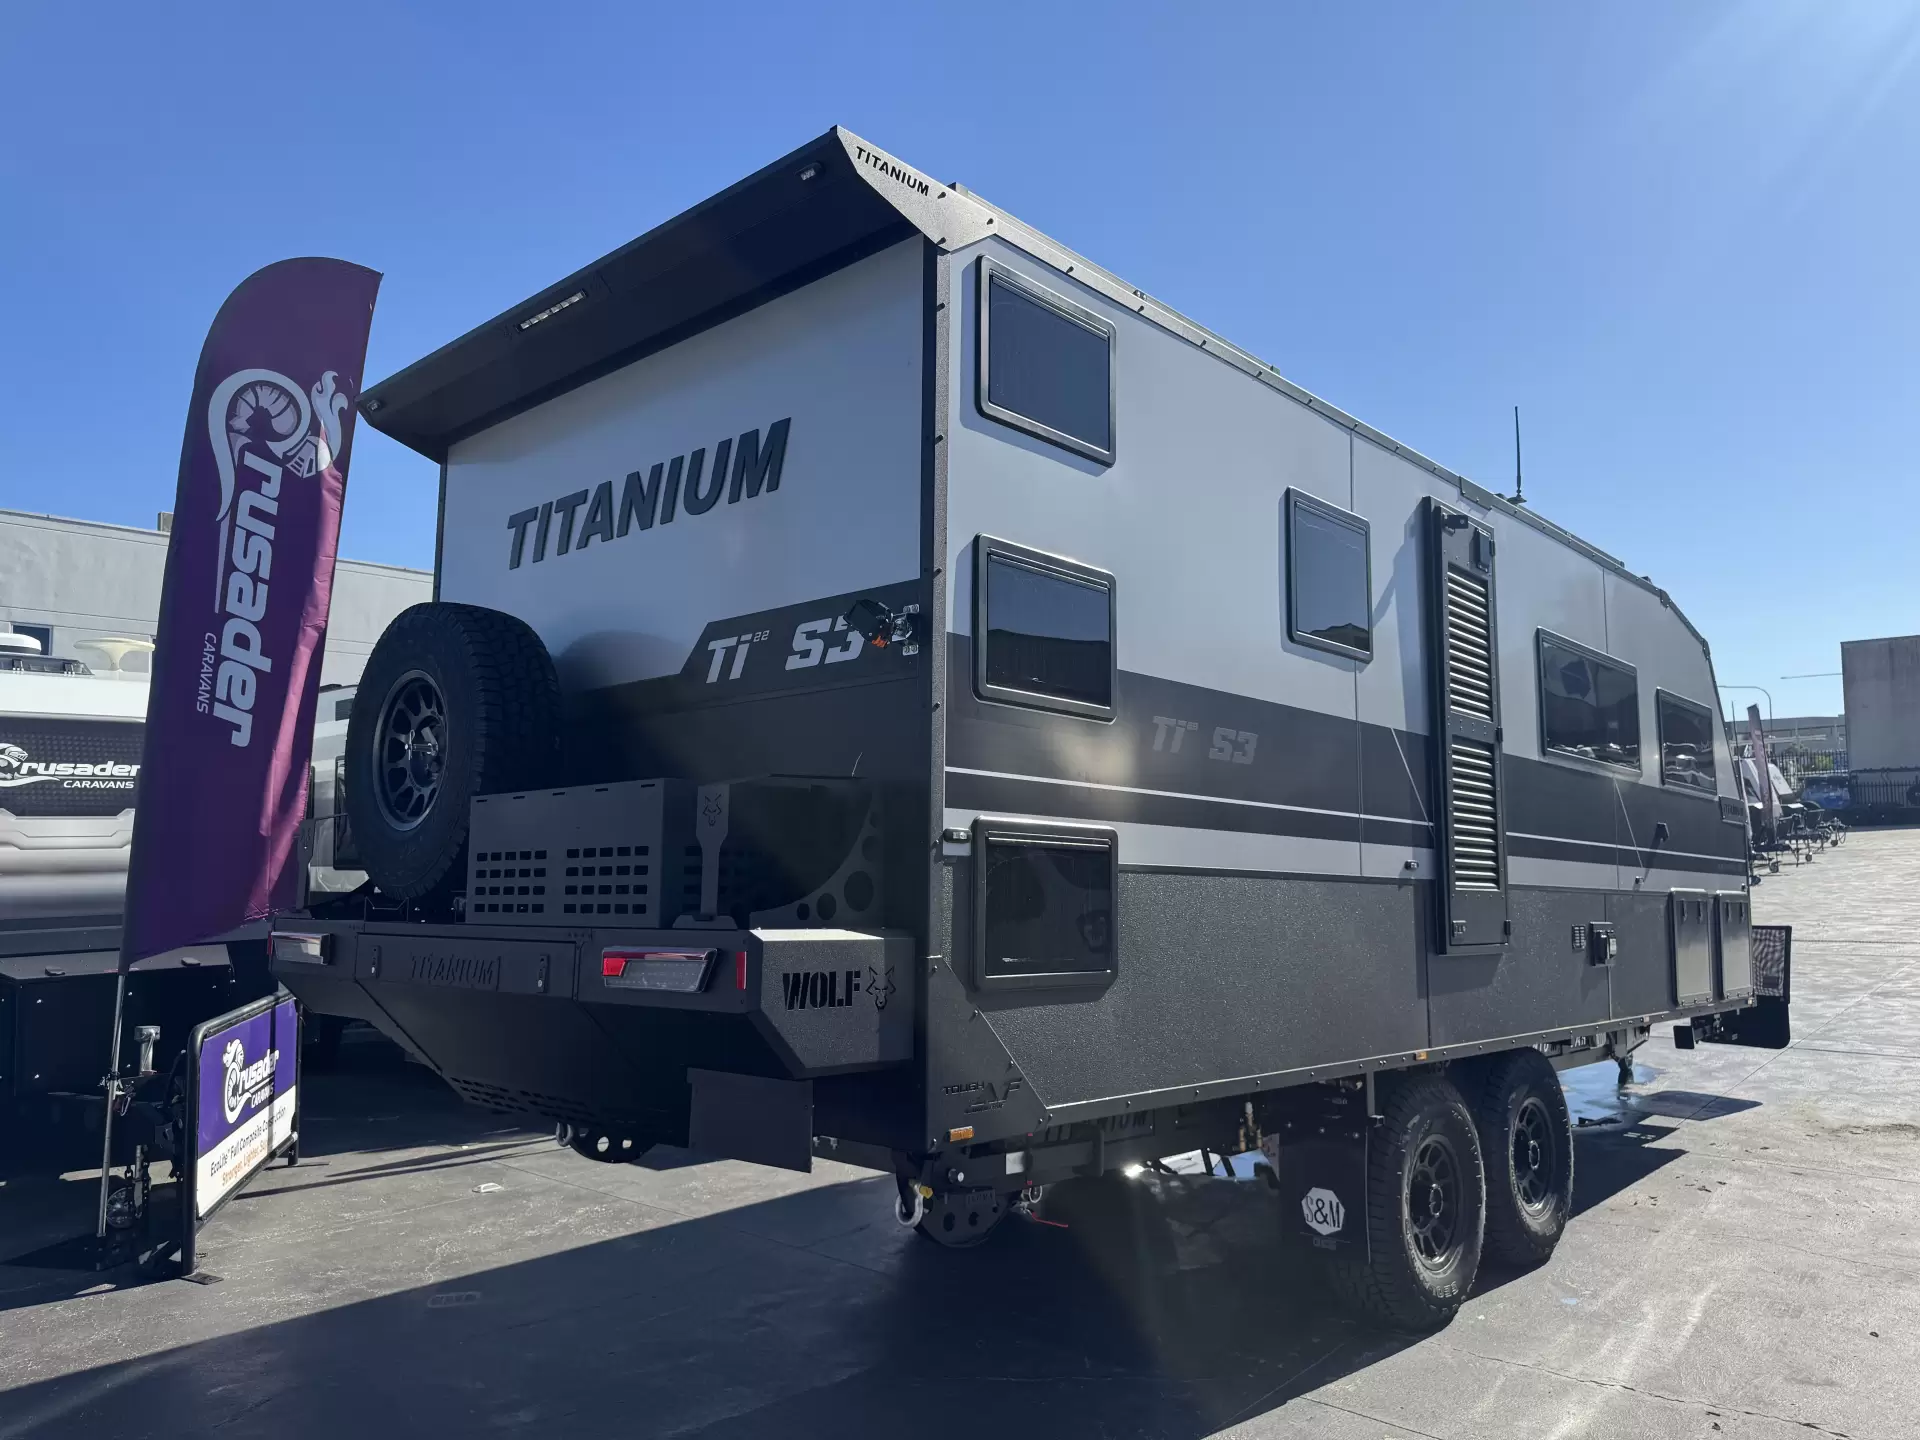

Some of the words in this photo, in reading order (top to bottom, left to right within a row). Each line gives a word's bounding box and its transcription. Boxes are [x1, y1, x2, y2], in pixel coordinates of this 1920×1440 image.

[855, 145, 930, 197] TITANIUM
[507, 415, 792, 570] TITANIUM
[208, 368, 312, 748] Crusader
[784, 615, 865, 672] S3
[196, 632, 216, 714] CARAVANS
[1208, 726, 1260, 765] S3
[63, 780, 135, 789] CARAVANS
[411, 955, 495, 986] TITANIUM
[782, 970, 861, 1010] WOLF
[225, 1048, 280, 1123] Crusader
[944, 1081, 985, 1095] TOUGH
[240, 1124, 262, 1151] Composite
[1305, 1195, 1341, 1229] S&M
